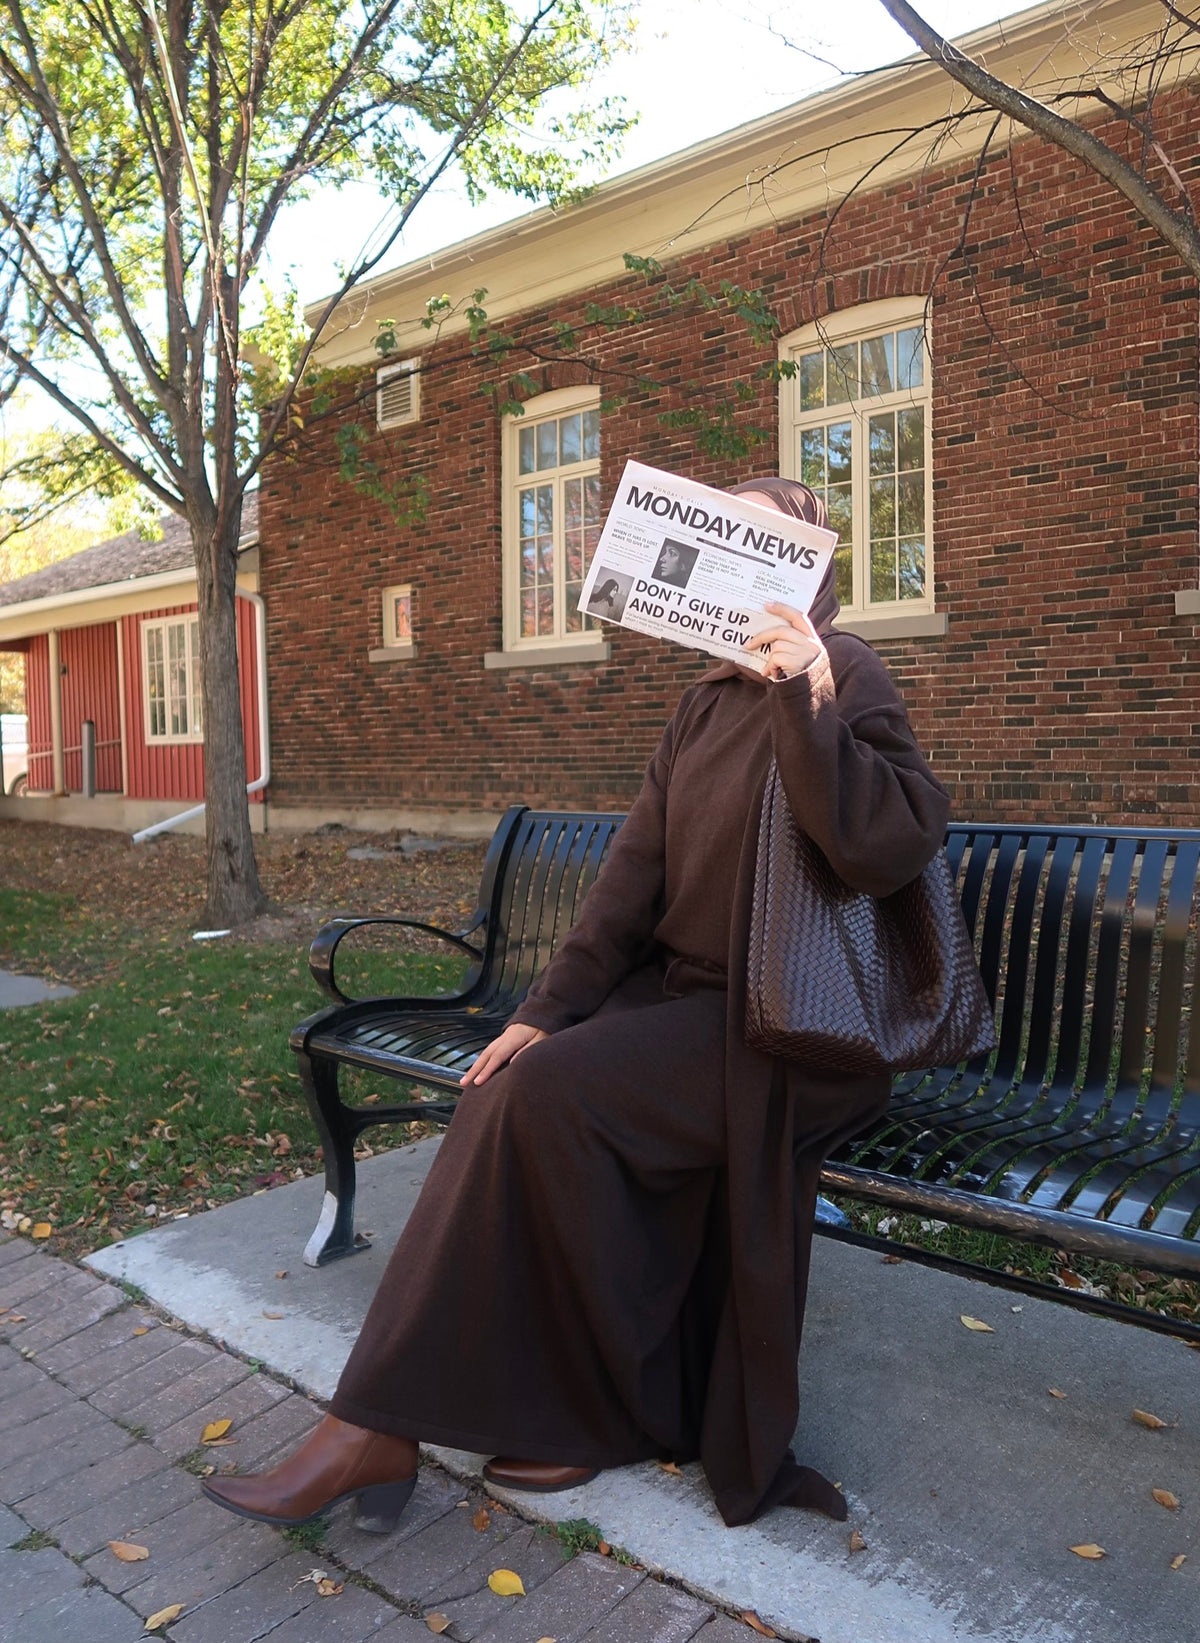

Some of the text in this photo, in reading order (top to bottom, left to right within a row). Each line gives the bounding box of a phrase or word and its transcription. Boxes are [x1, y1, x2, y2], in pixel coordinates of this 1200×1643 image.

[626, 486, 741, 540] MONDAY
[742, 527, 818, 569] NEWS
[628, 598, 665, 618] AND
[667, 610, 719, 637] DON'T
[722, 629, 754, 646] GIV
[635, 579, 687, 606] DON'T
[688, 598, 725, 620] GIVE
[728, 610, 750, 626] UP
